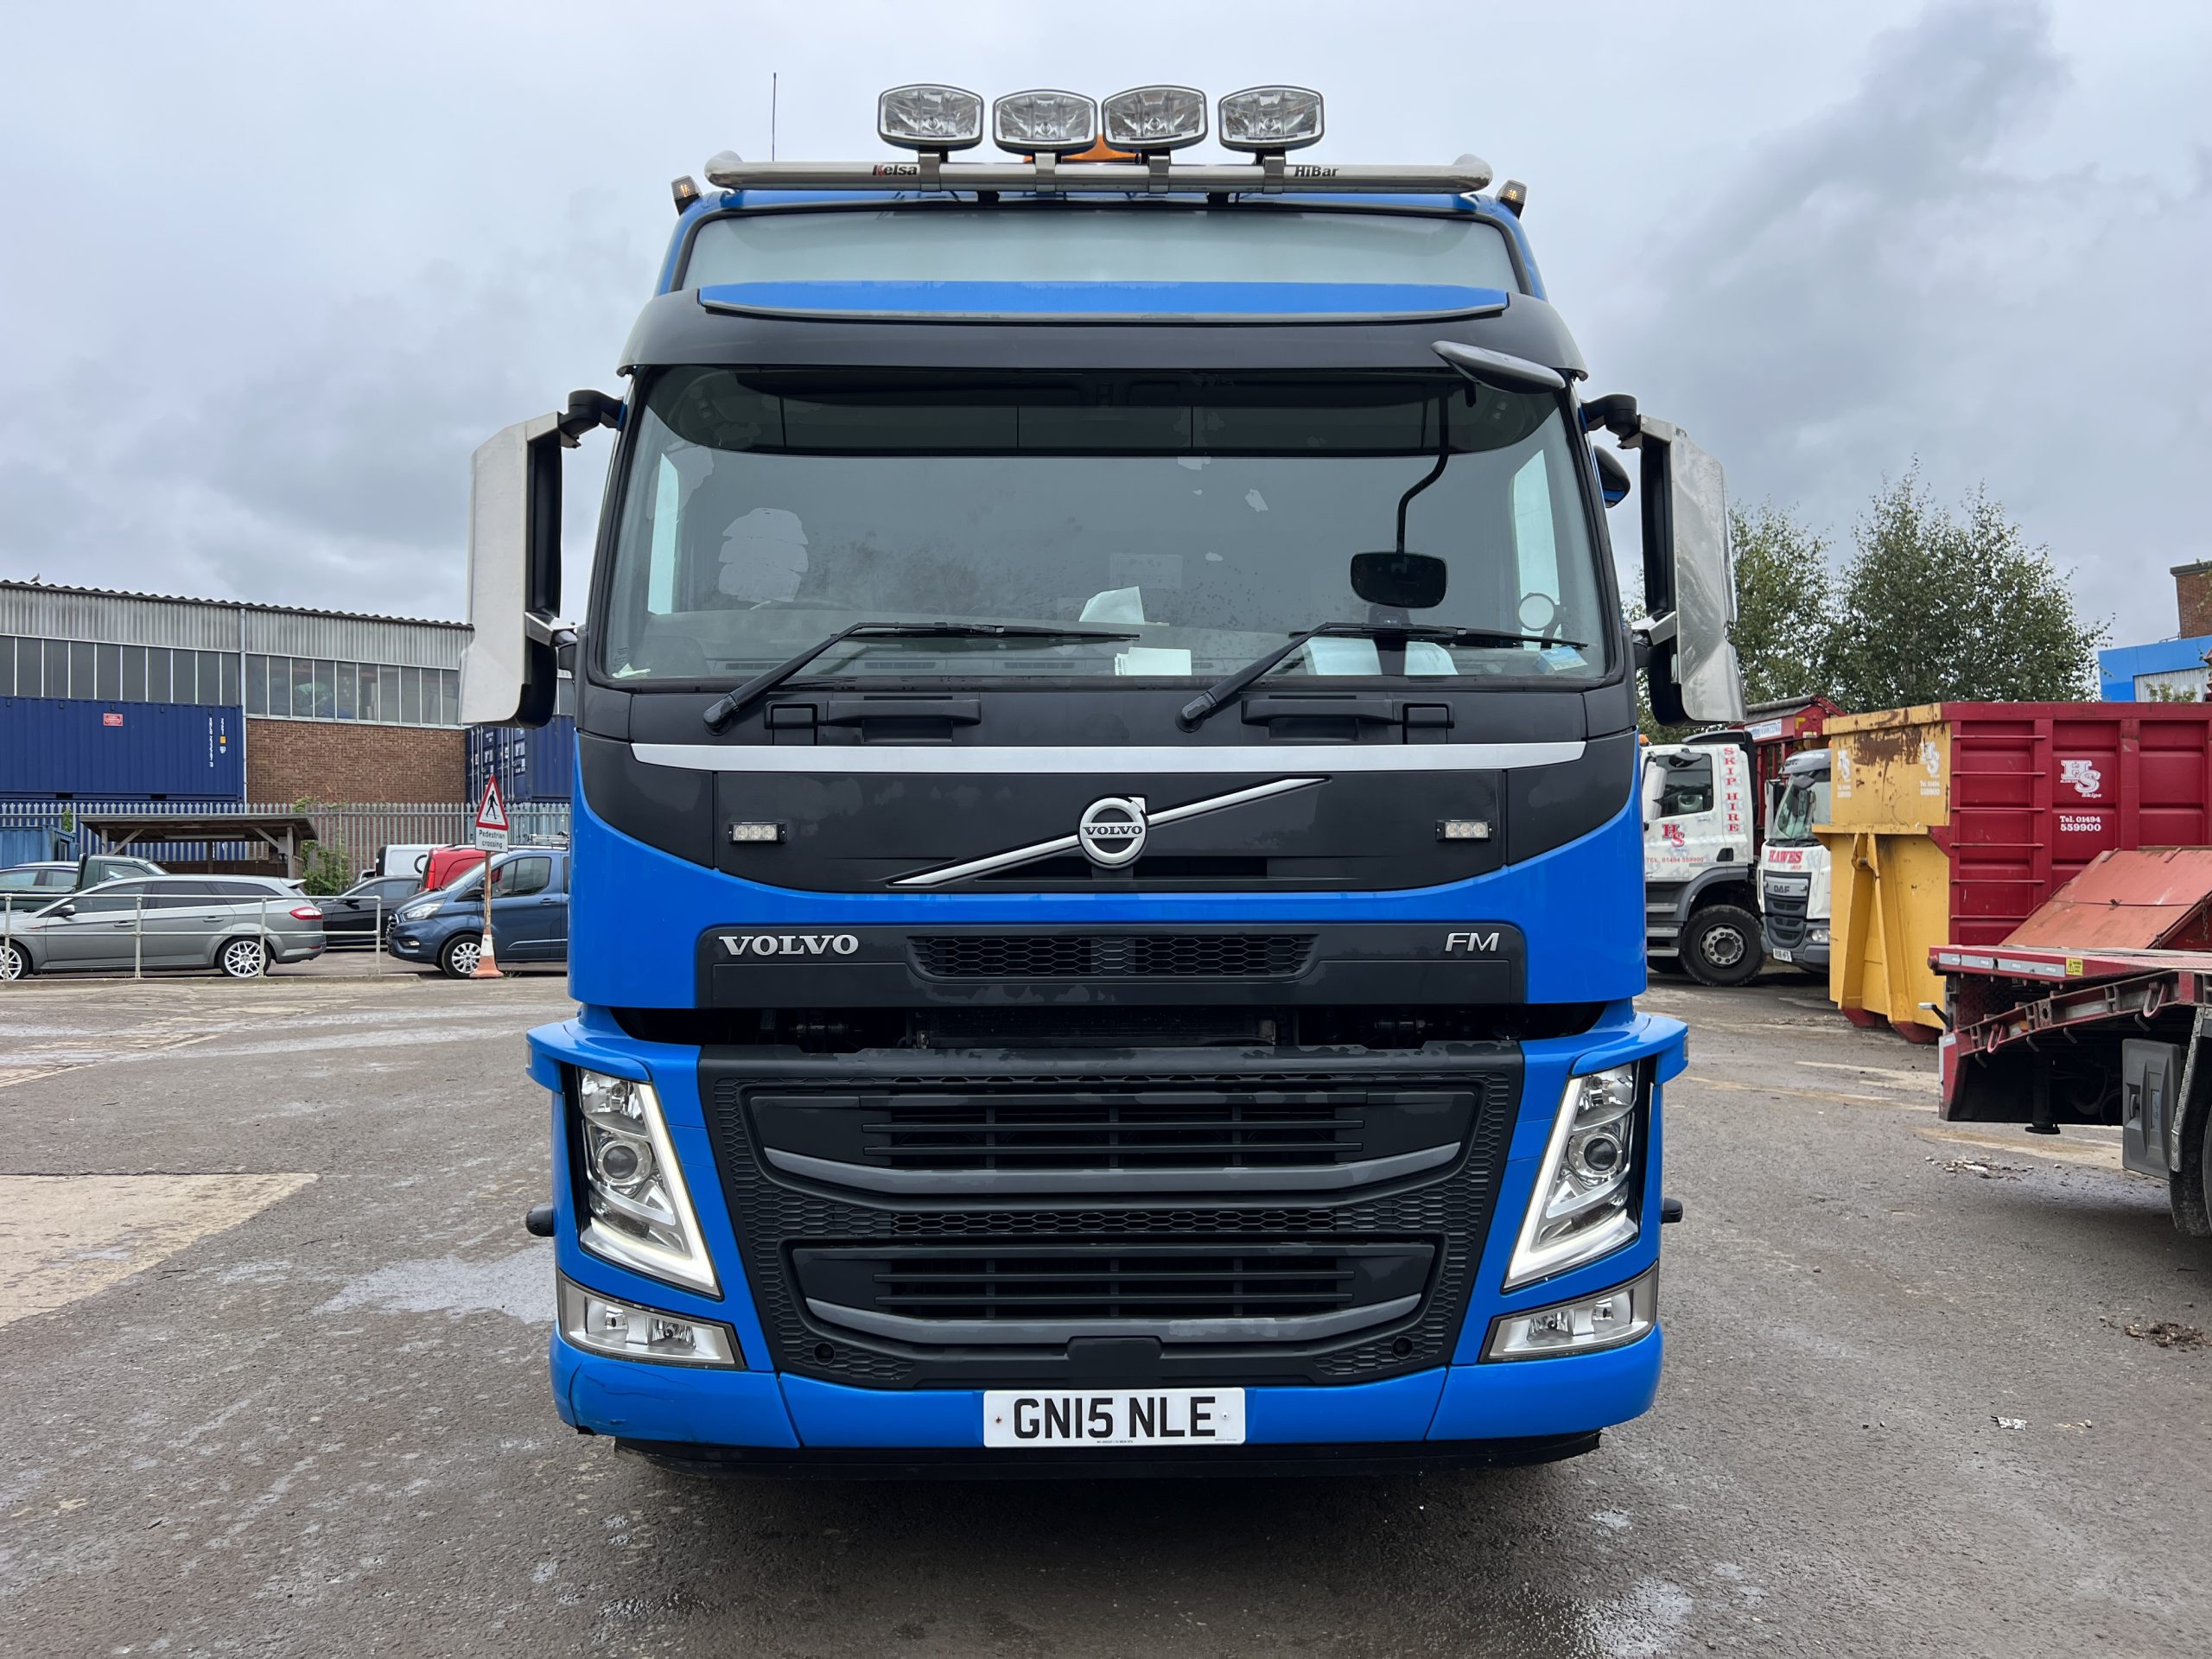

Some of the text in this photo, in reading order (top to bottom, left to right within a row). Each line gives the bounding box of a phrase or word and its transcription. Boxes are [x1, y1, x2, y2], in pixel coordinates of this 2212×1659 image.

[872, 164, 918, 176] Kelsa
[1294, 166, 1339, 177] HiBar
[2061, 760, 2101, 793] HS
[1724, 747, 1739, 831] SKIP HIRE
[479, 830, 505, 838] Pedestrian
[1083, 826, 1143, 836] VOLVO
[1662, 823, 1685, 847] HS
[1769, 850, 1802, 863] HAWES
[1774, 885, 1789, 893] DAF
[719, 935, 859, 956] VOLVO
[1445, 932, 1499, 951] FM
[1014, 1396, 1216, 1439] GN15 NLE
